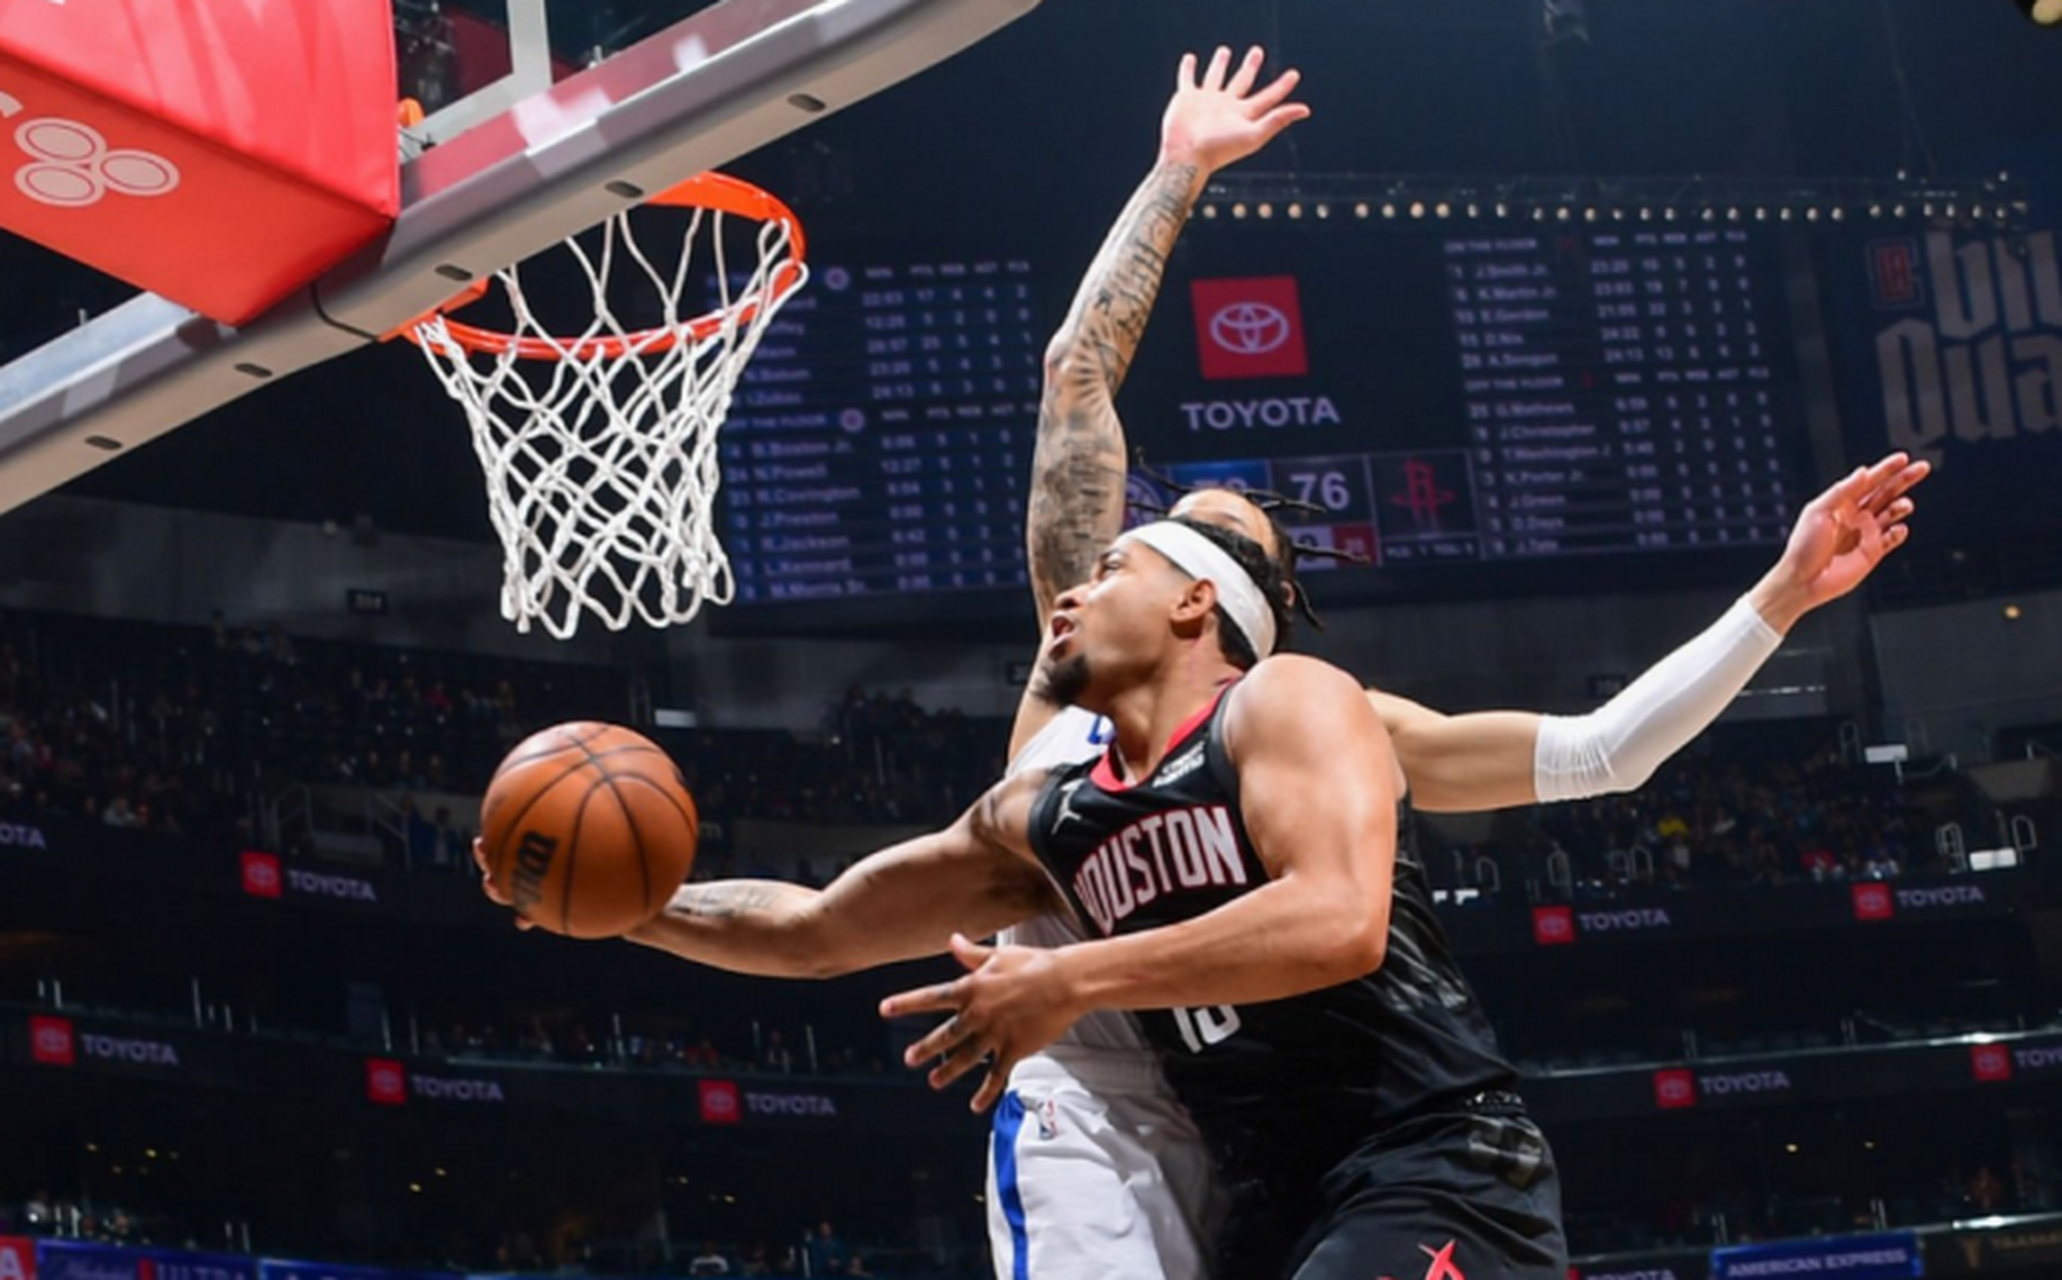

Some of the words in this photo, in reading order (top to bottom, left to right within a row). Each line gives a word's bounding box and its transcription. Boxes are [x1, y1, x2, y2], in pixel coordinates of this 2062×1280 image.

[1181, 397, 1341, 431] TOYOTA
[1288, 471, 1350, 511] 76
[0, 823, 46, 849] OTA
[1073, 806, 1248, 936] HOUSTON
[288, 870, 376, 901] TOYOTA
[1897, 886, 1985, 908] TOYOTA
[1580, 909, 1670, 932] TOYOTA
[82, 1034, 179, 1065] TOYOTA
[412, 1075, 504, 1101] TOYOTA
[1701, 1072, 1789, 1095] TOYOTA
[745, 1092, 836, 1116] TOYOTA
[1727, 1257, 1821, 1278] AMERICAN
[1825, 1248, 1907, 1270] EXPRESS
